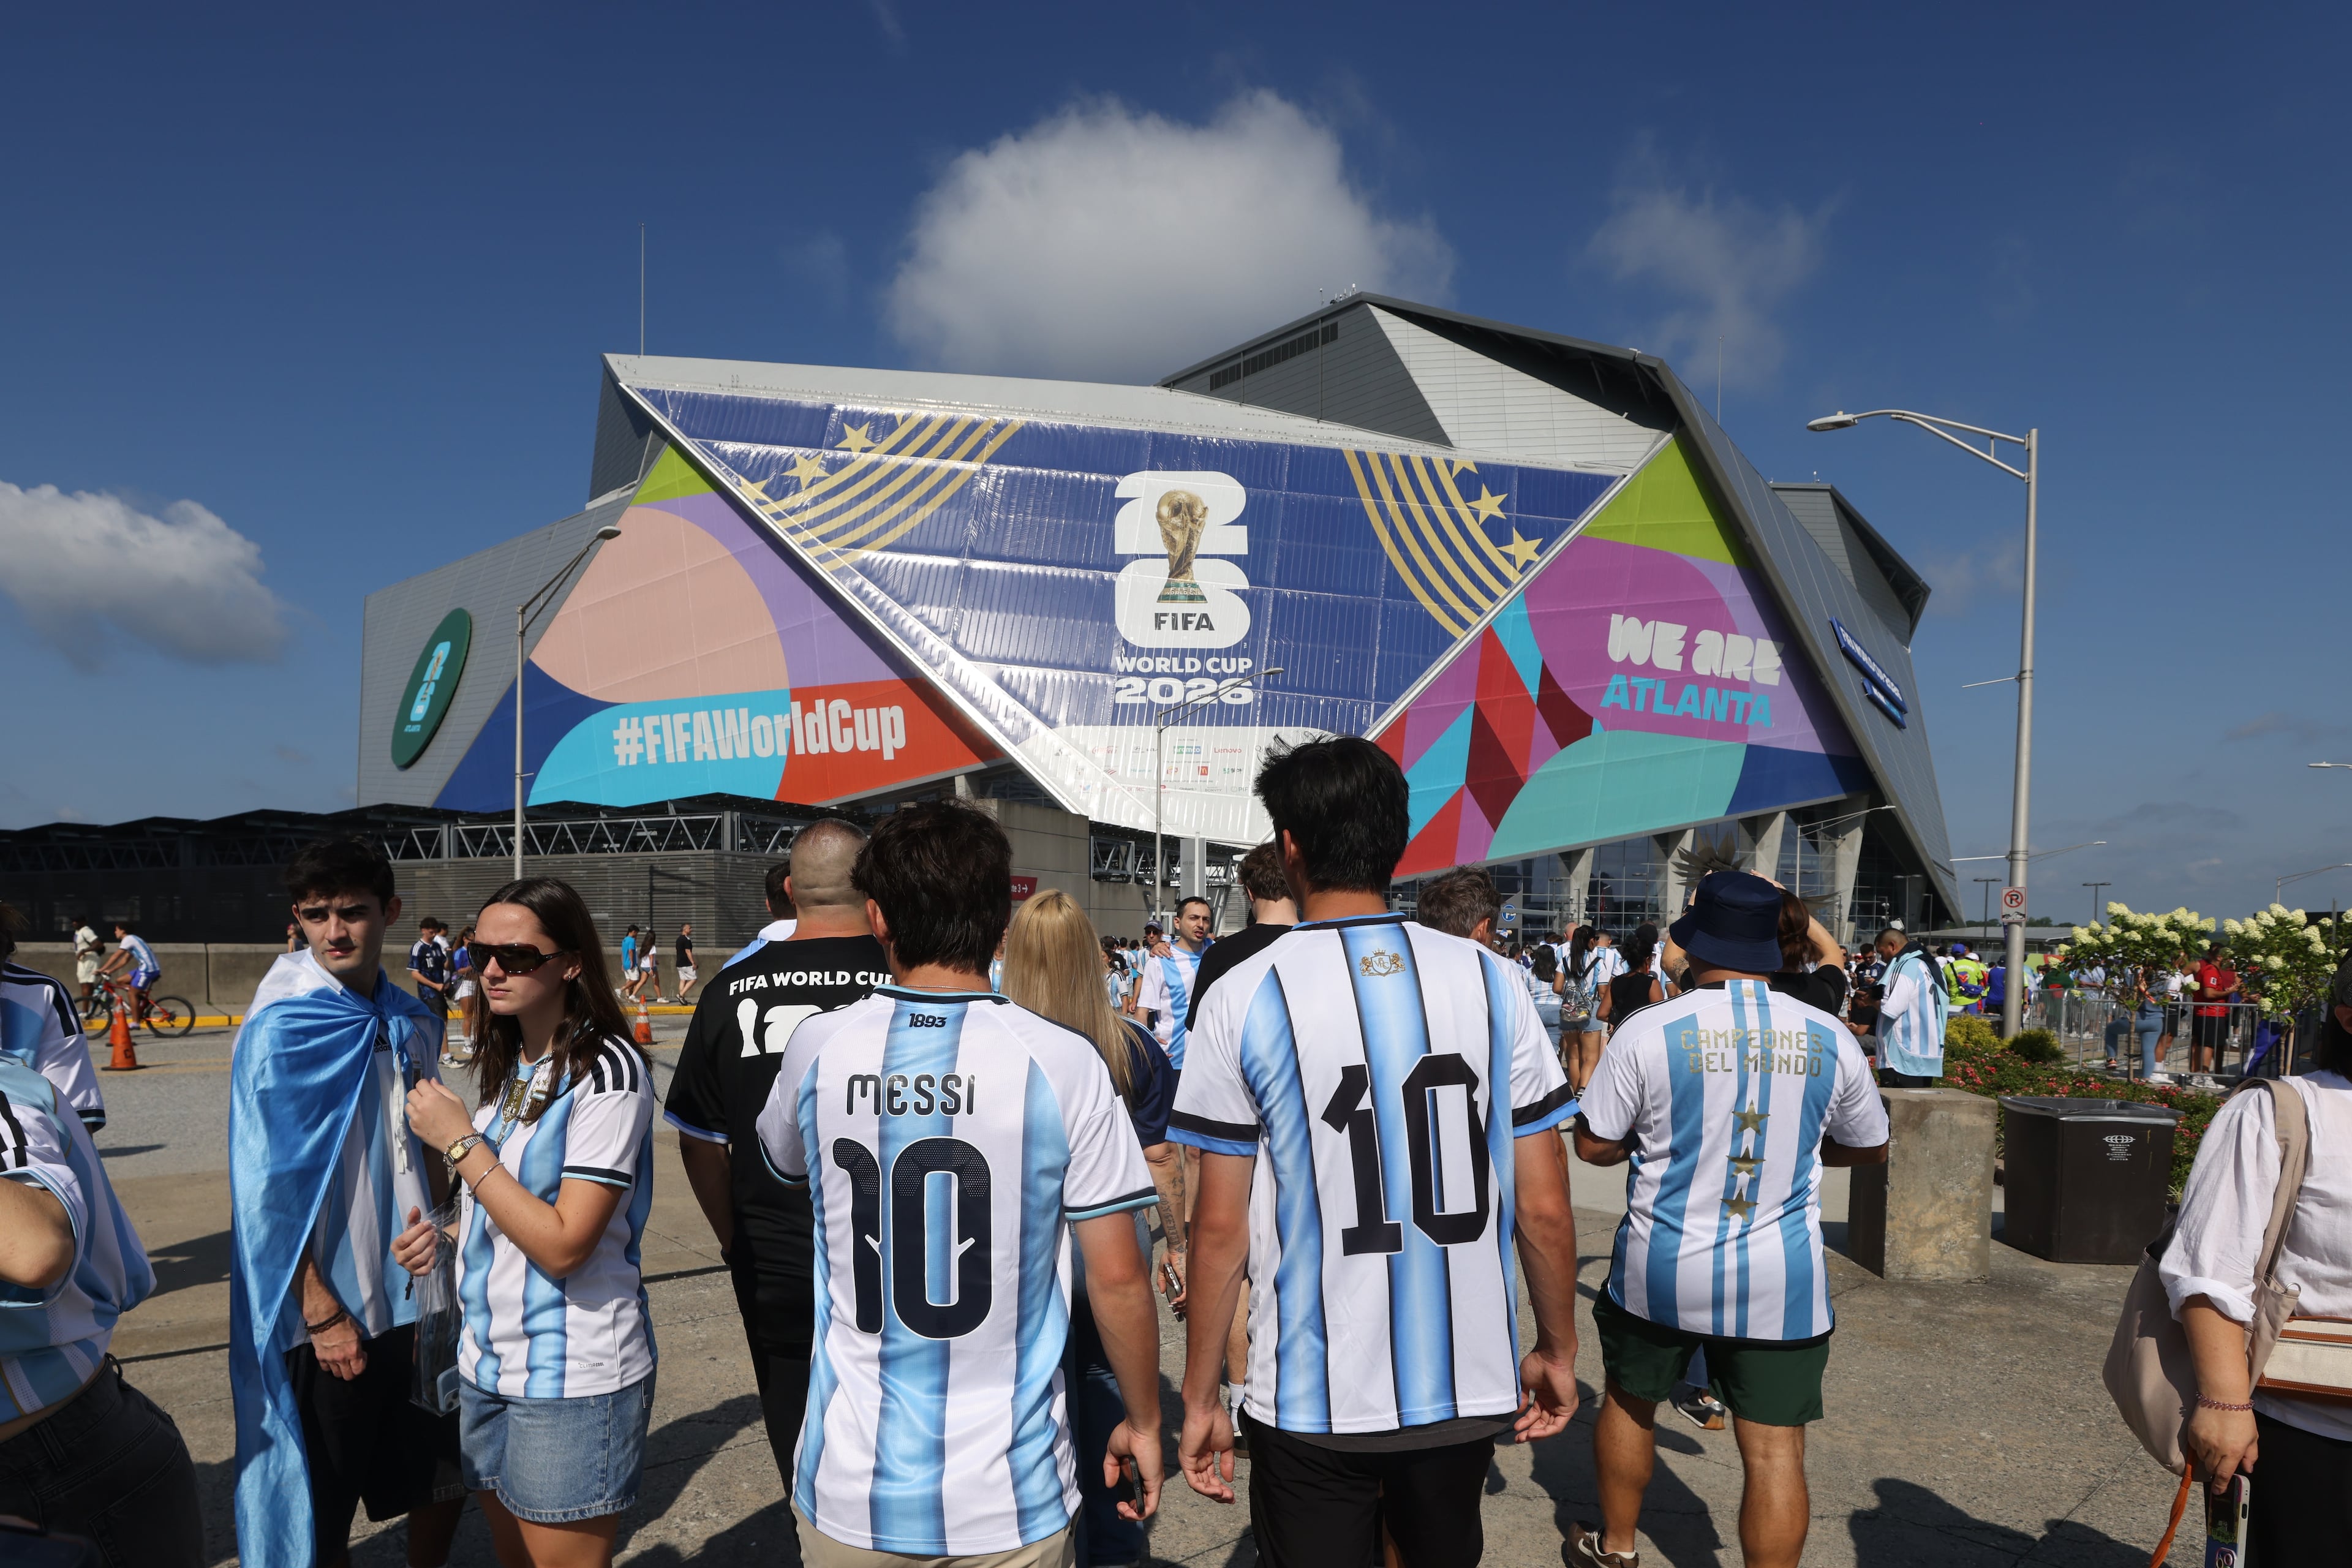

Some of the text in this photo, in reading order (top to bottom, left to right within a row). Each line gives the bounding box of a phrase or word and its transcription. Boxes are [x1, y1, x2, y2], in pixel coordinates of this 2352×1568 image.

[1155, 612, 1215, 630] FIFA
[1608, 614, 1687, 671] WE
[1115, 657, 1253, 673] WORLD CUP
[1115, 677, 1253, 704] 2026
[1599, 674, 1772, 728] ATLANTA
[612, 699, 907, 766] #FIFAWorldCup
[729, 974, 768, 997] FIFA
[772, 971, 851, 987] WORLD
[909, 1013, 948, 1028] 1893
[1681, 1028, 1823, 1054] CAMPEONES
[1689, 1052, 1822, 1077] DEL MUNDO
[846, 1074, 976, 1116] MESSI
[1321, 1053, 1490, 1256] 10
[832, 1137, 992, 1340] 10
